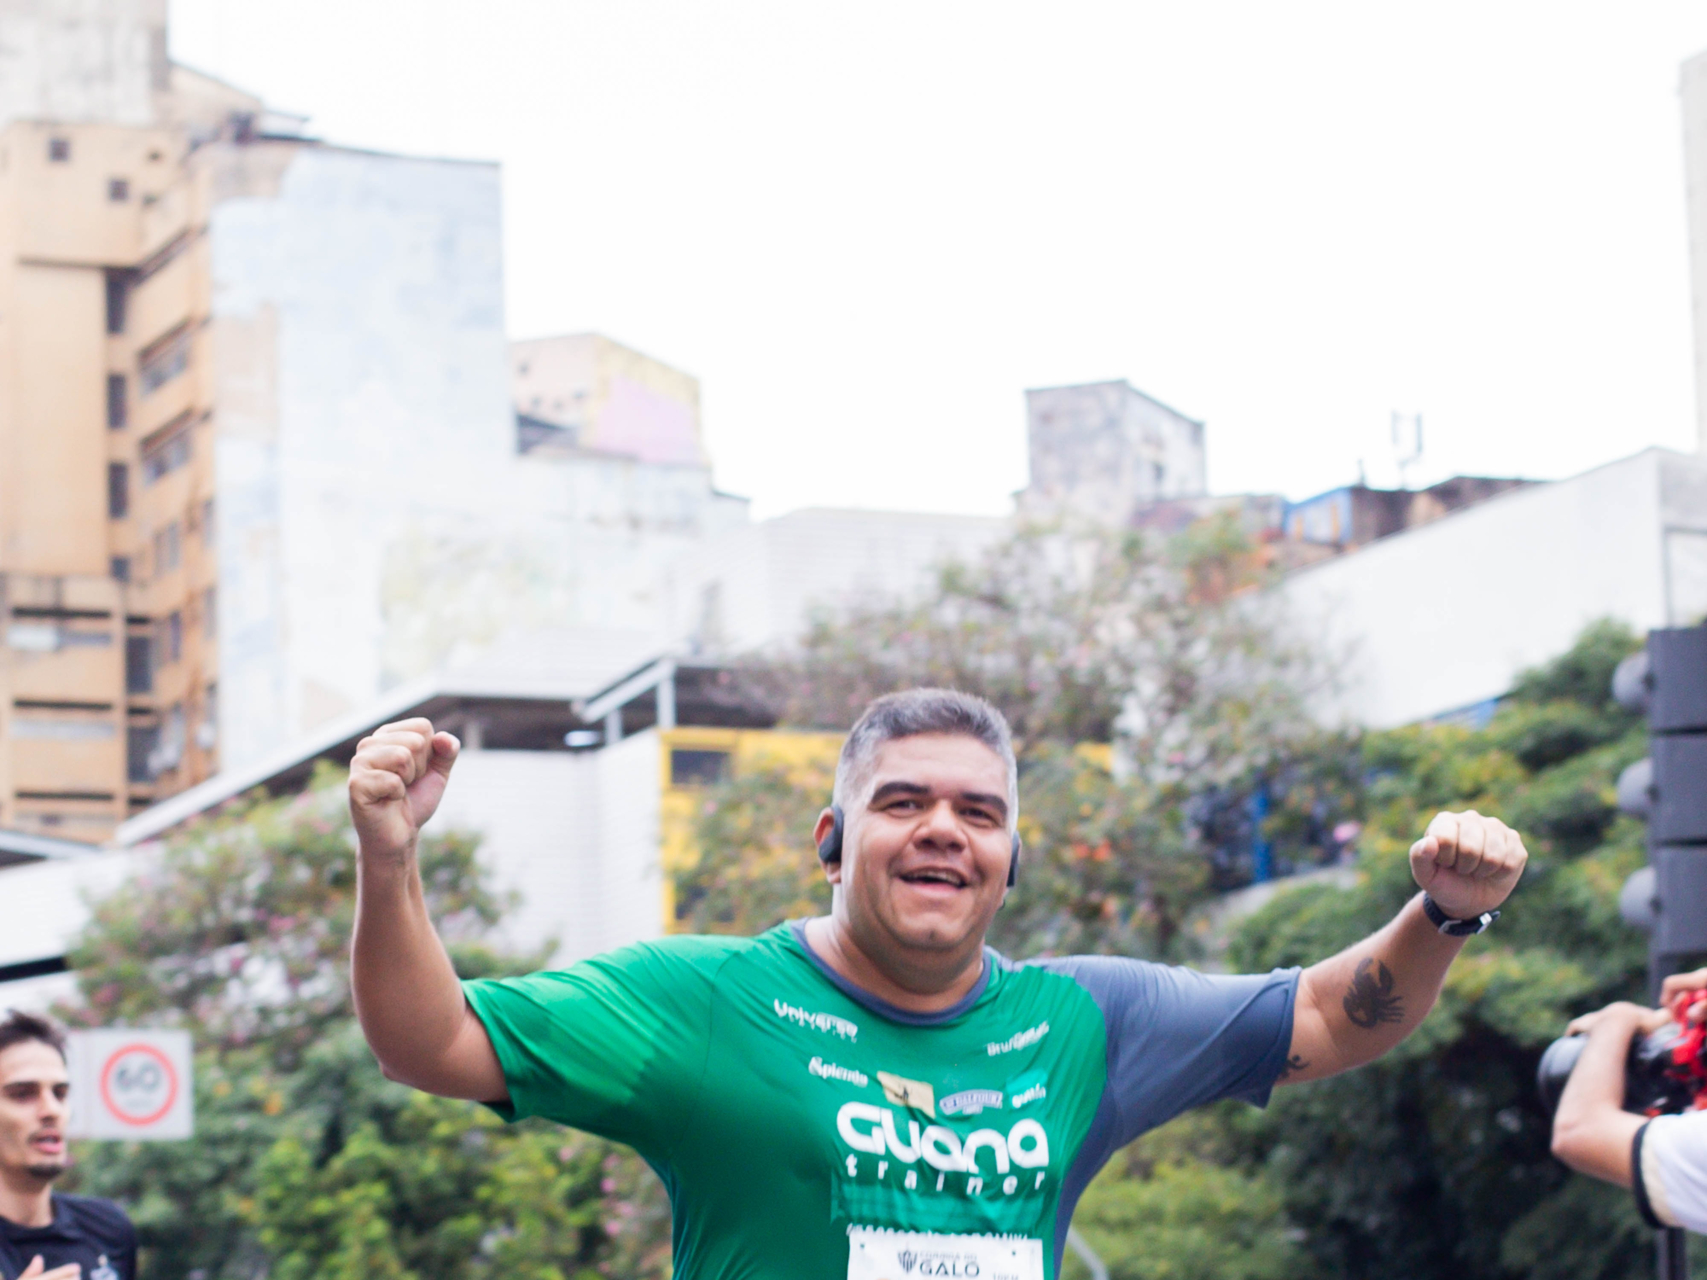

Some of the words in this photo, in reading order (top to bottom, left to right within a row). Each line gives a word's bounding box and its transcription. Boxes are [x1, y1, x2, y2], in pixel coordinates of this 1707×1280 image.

[115, 1063, 162, 1092] 60
[845, 1153, 1045, 1196] trainer
[919, 1259, 980, 1279] GALO
